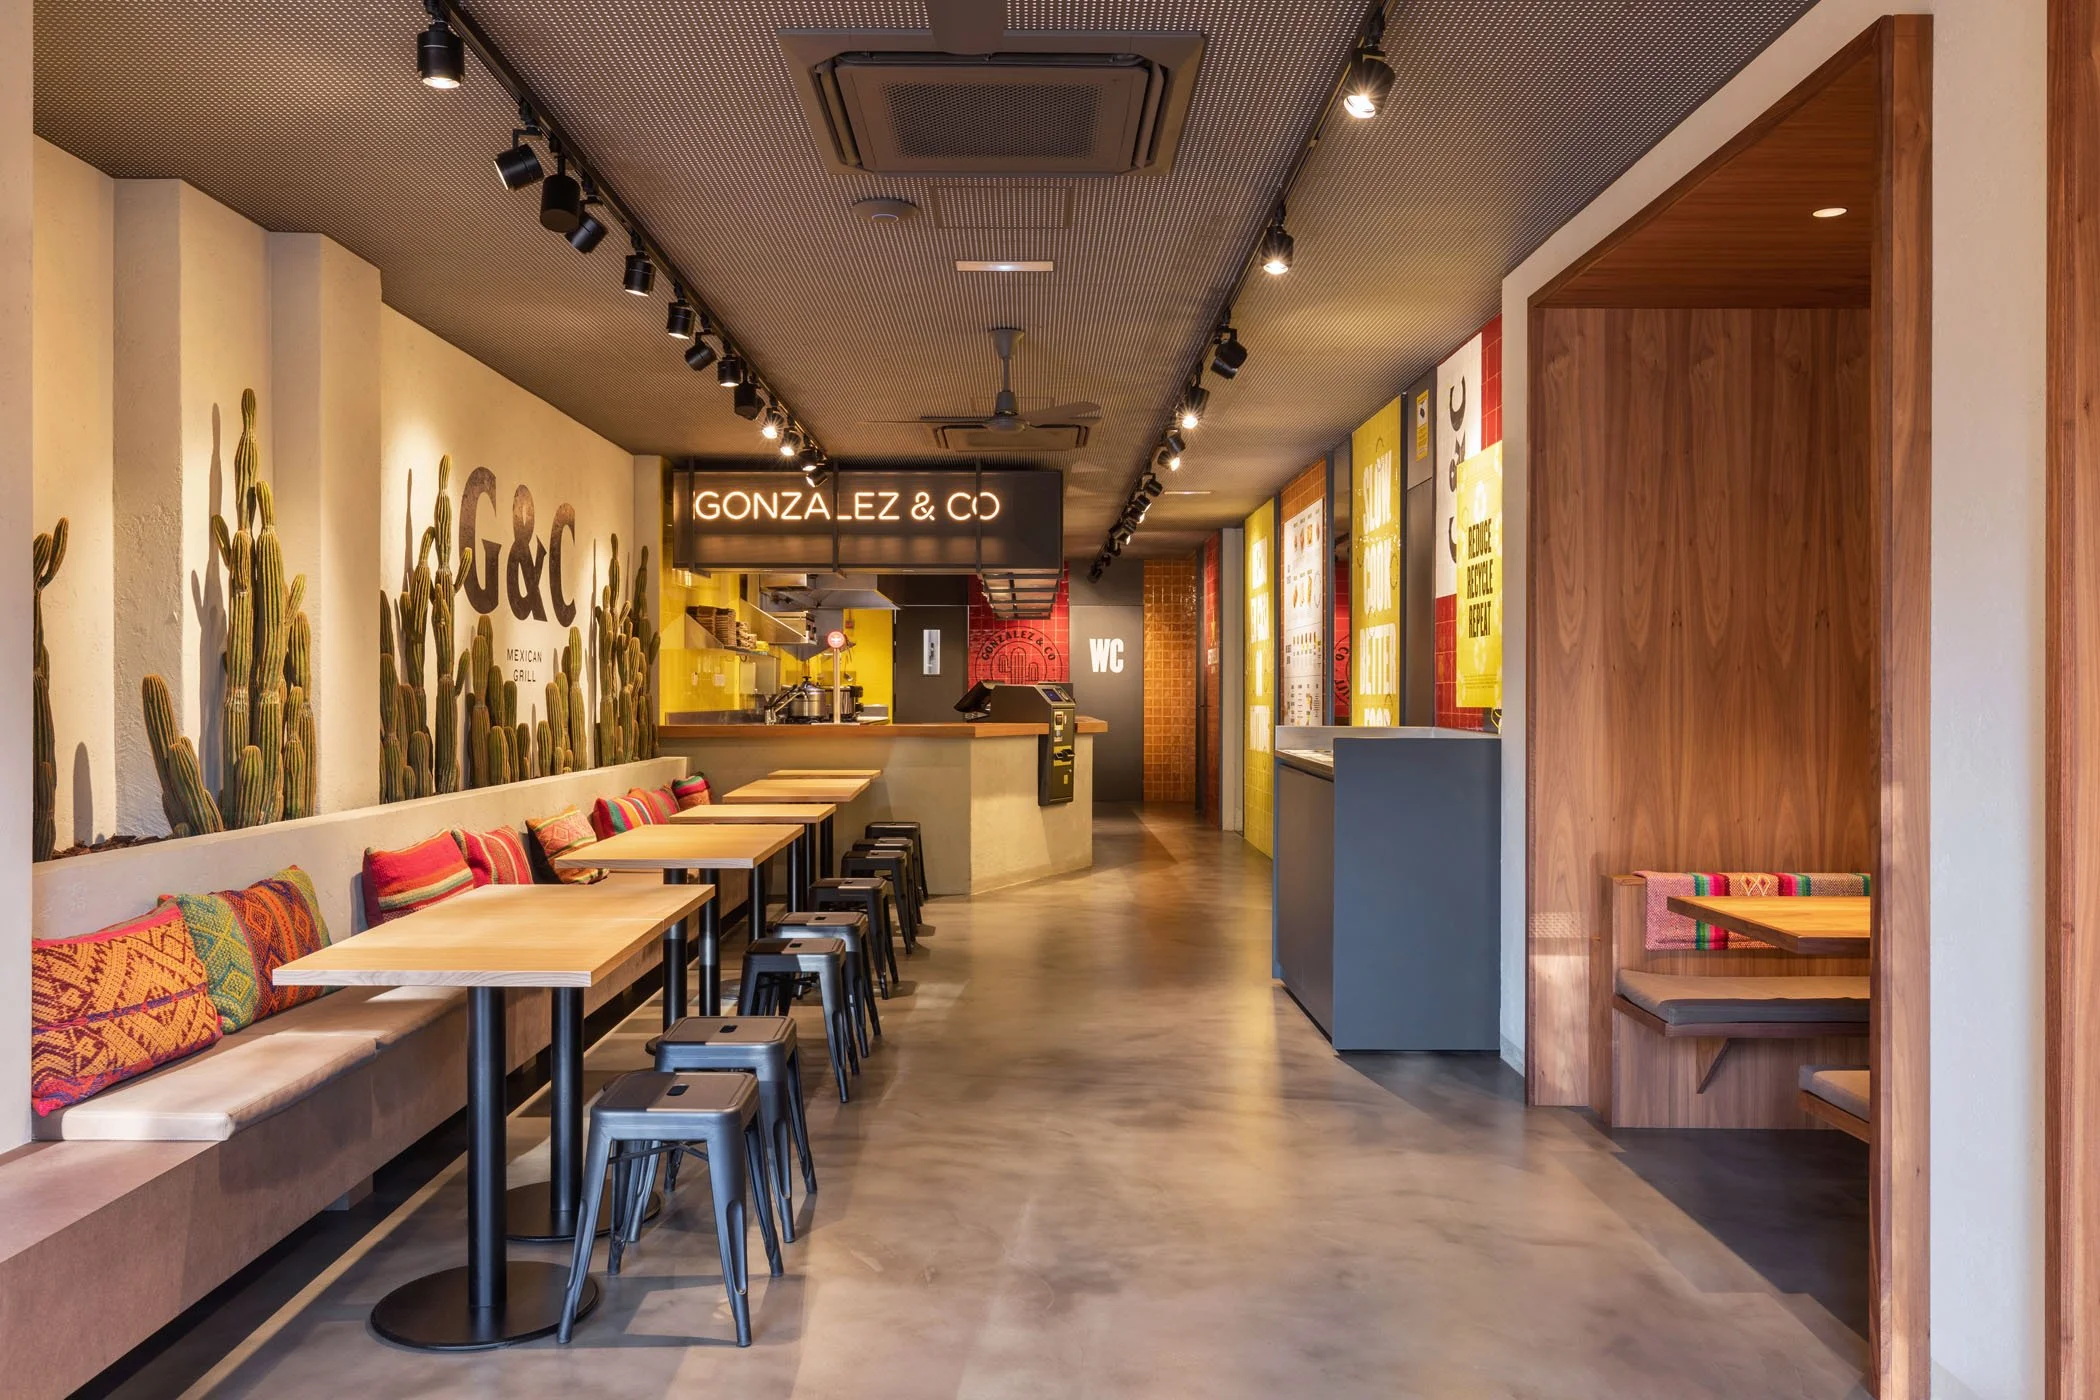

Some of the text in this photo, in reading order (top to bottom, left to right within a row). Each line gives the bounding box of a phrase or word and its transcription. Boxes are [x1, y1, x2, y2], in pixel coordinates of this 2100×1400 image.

[911, 490, 936, 521] &
[946, 490, 1001, 521] CO
[1363, 449, 1392, 534] SLOW
[459, 466, 577, 628] G&C
[1467, 517, 1492, 560] REDUCE
[1363, 538, 1392, 616] COOK
[1466, 558, 1494, 600] RECYCLE
[1468, 600, 1492, 639] REPEAT
[506, 647, 543, 663] MEXICAN
[981, 629, 1056, 661] GONZALEZ & CO
[1089, 638, 1124, 673] WC
[1359, 622, 1397, 695] BETTER
[513, 668, 537, 683] GRILL
